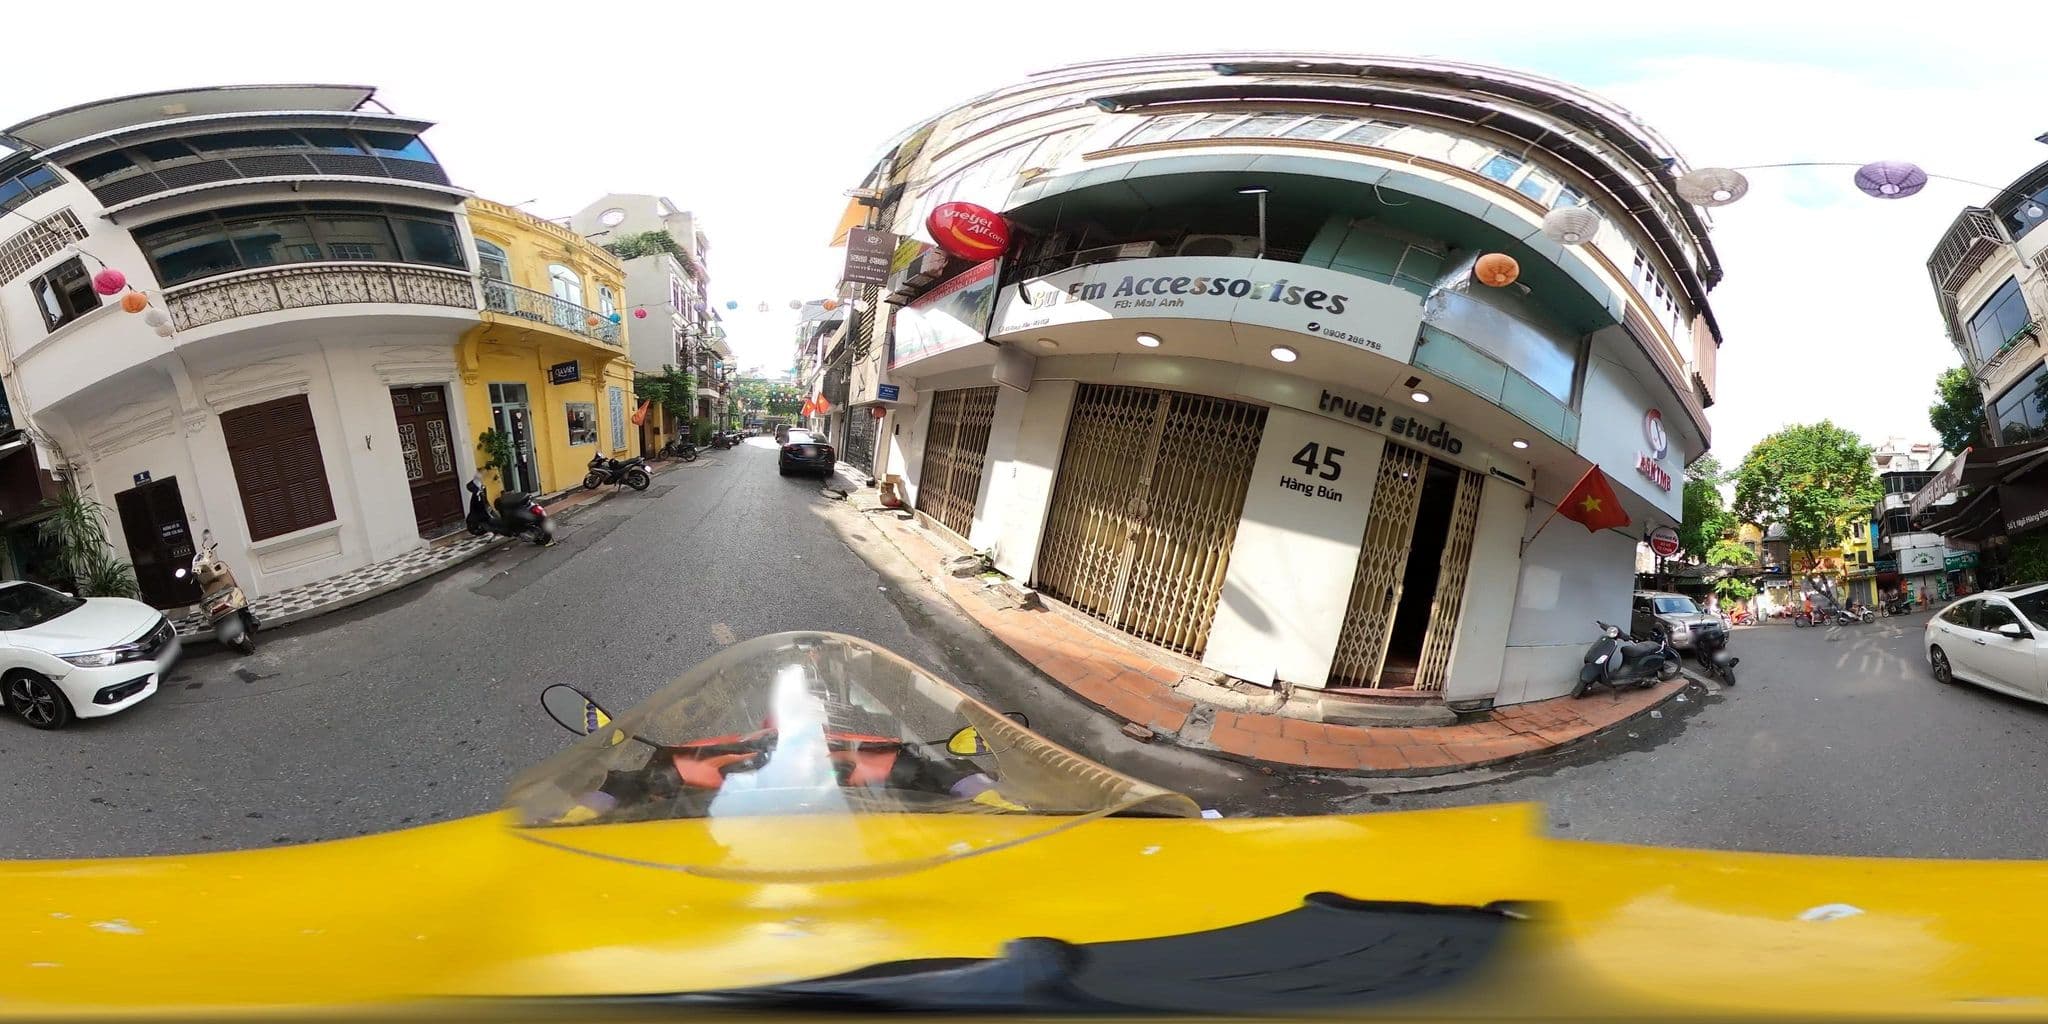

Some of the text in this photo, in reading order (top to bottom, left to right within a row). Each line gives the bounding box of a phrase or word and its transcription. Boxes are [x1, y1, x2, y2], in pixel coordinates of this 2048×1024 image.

[1064, 281, 1107, 304] Em
[1112, 275, 1349, 315] Accessorises
[1159, 297, 1185, 307] Anh
[1391, 417, 1463, 455] studio
[1291, 441, 1346, 482] 45
[1279, 475, 1344, 502] Hàng Bún
